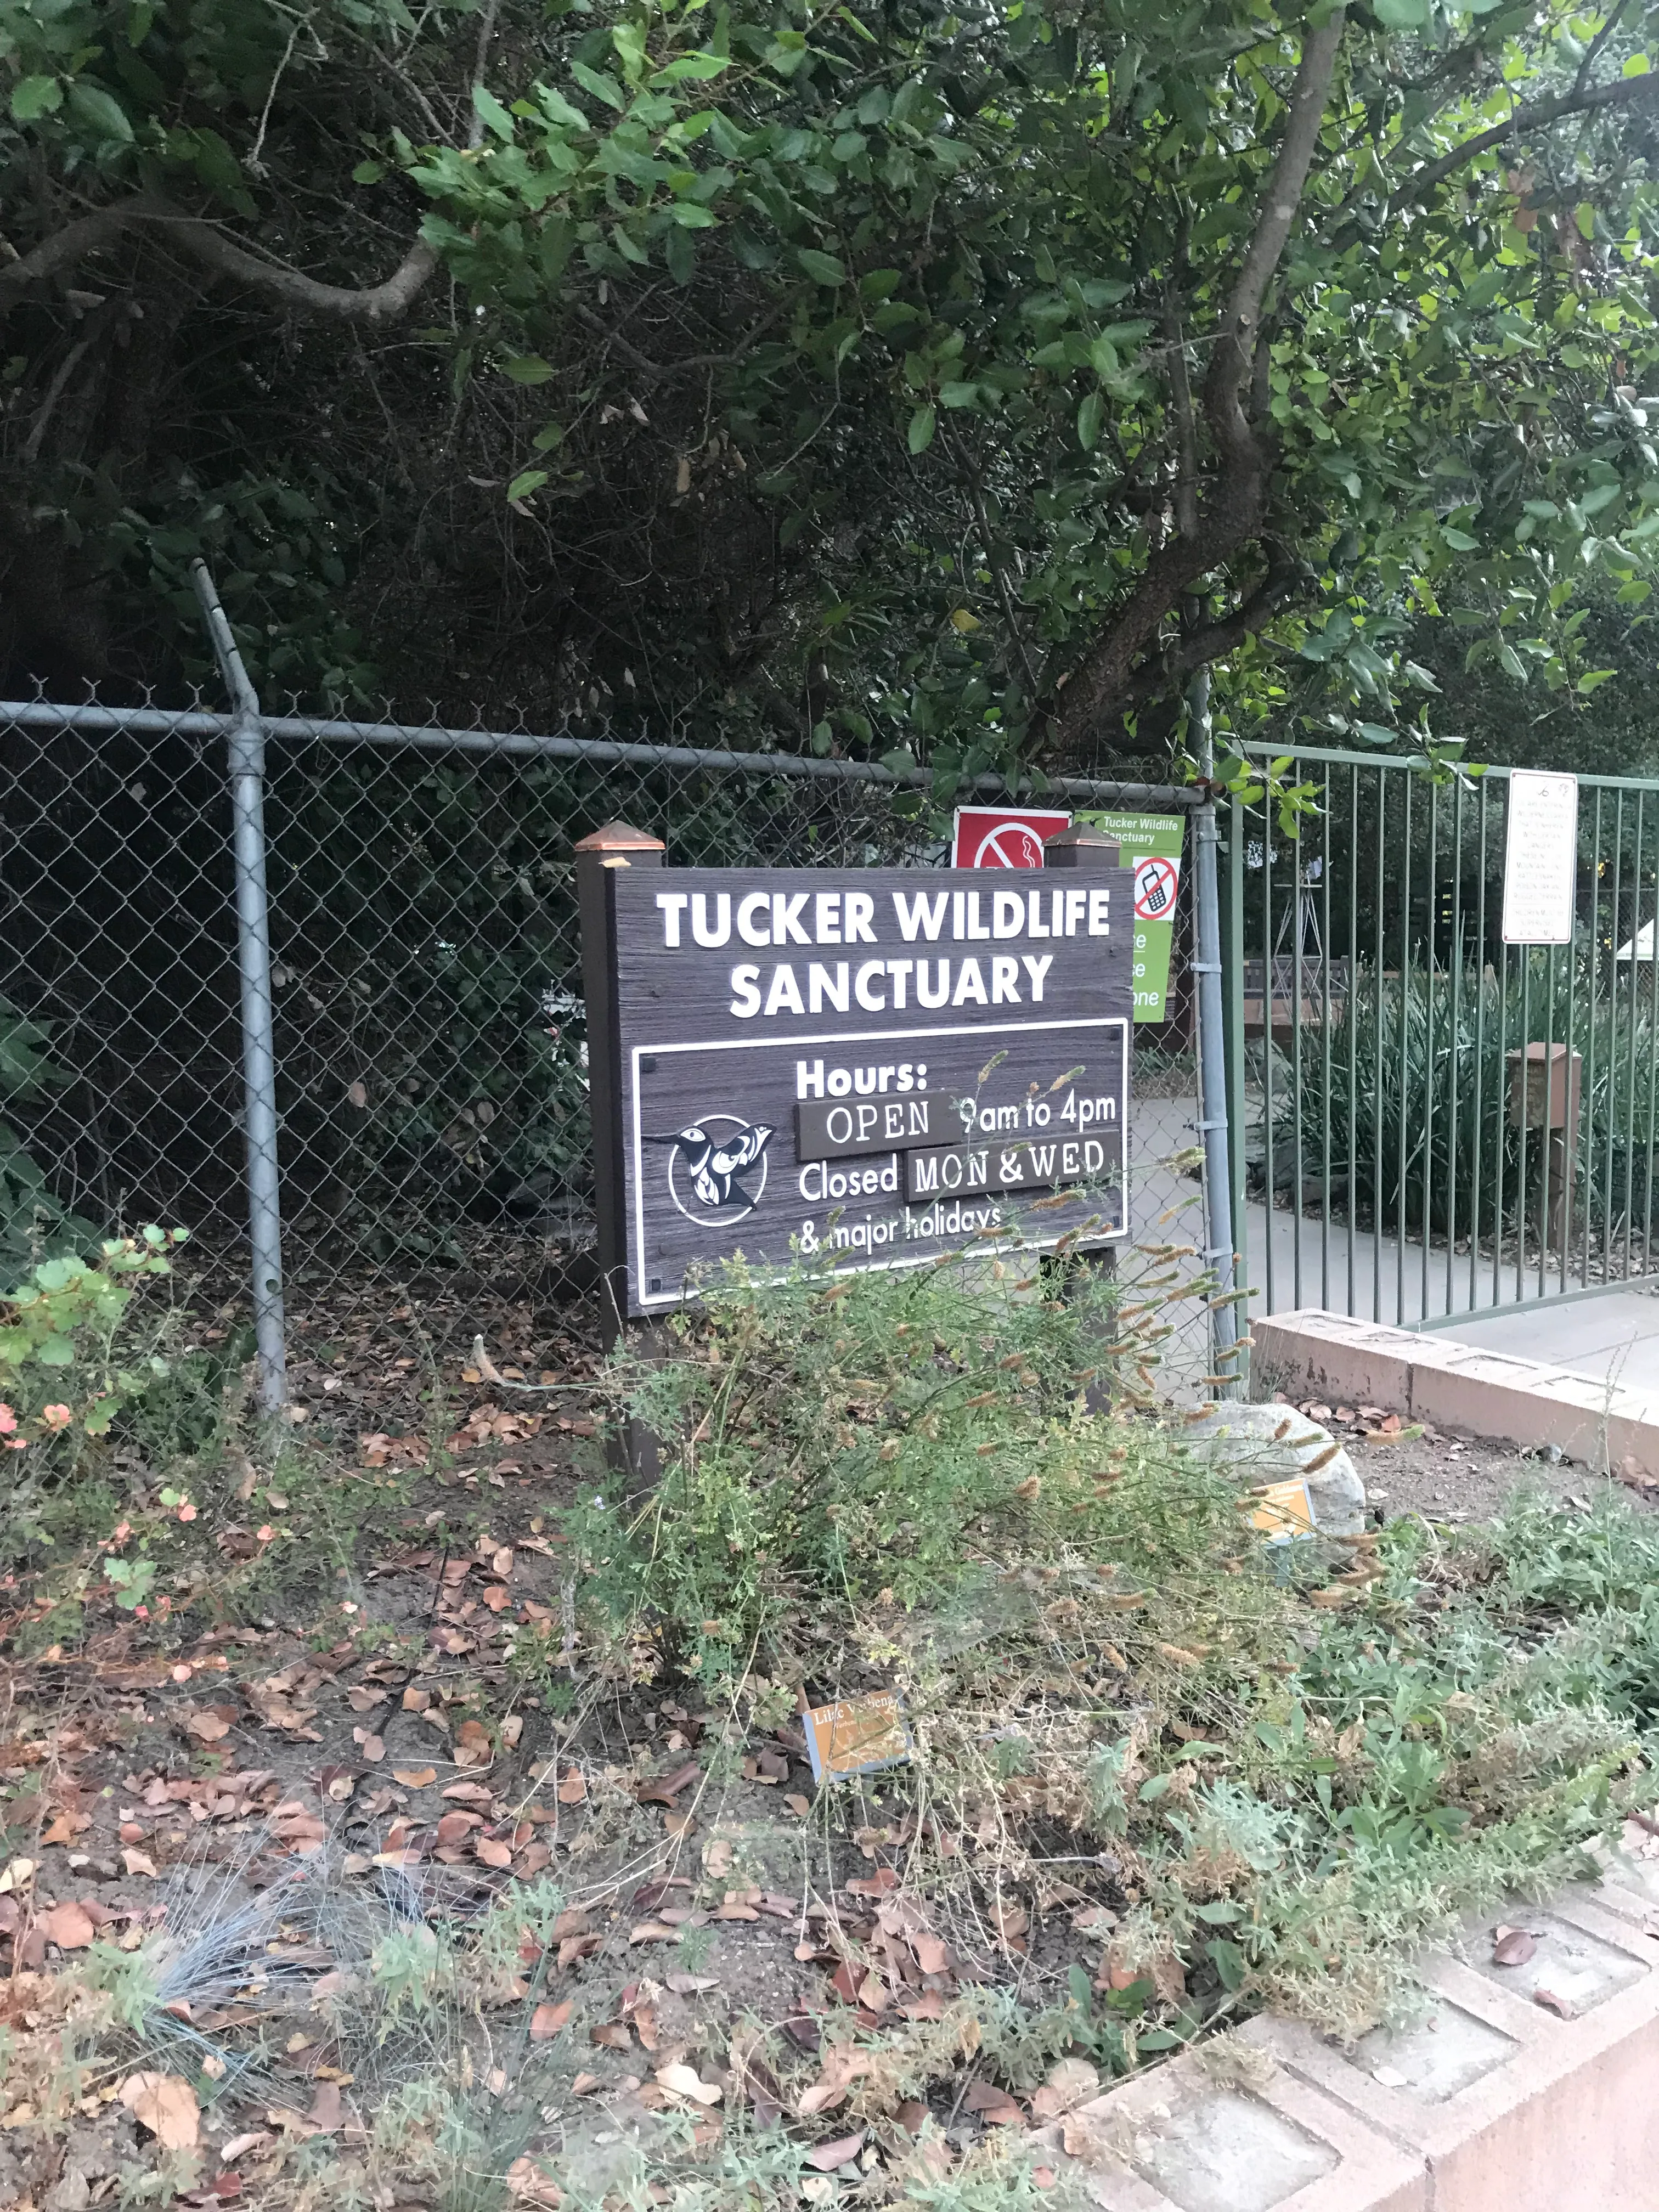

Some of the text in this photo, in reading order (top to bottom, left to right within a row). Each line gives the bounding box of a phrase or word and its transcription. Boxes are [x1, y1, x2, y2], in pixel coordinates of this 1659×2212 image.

[1104, 816, 1178, 831] Tucker Wildlife
[657, 889, 1110, 948] TUCKER WILDLIFE
[729, 955, 1054, 1018] SANCTUARY
[796, 1059, 928, 1099] Hours:
[826, 1087, 1116, 1144] OPEN 9am to 4pm
[798, 1141, 1104, 1202] Closed MON & WED
[799, 1200, 1002, 1256] & major holidays
